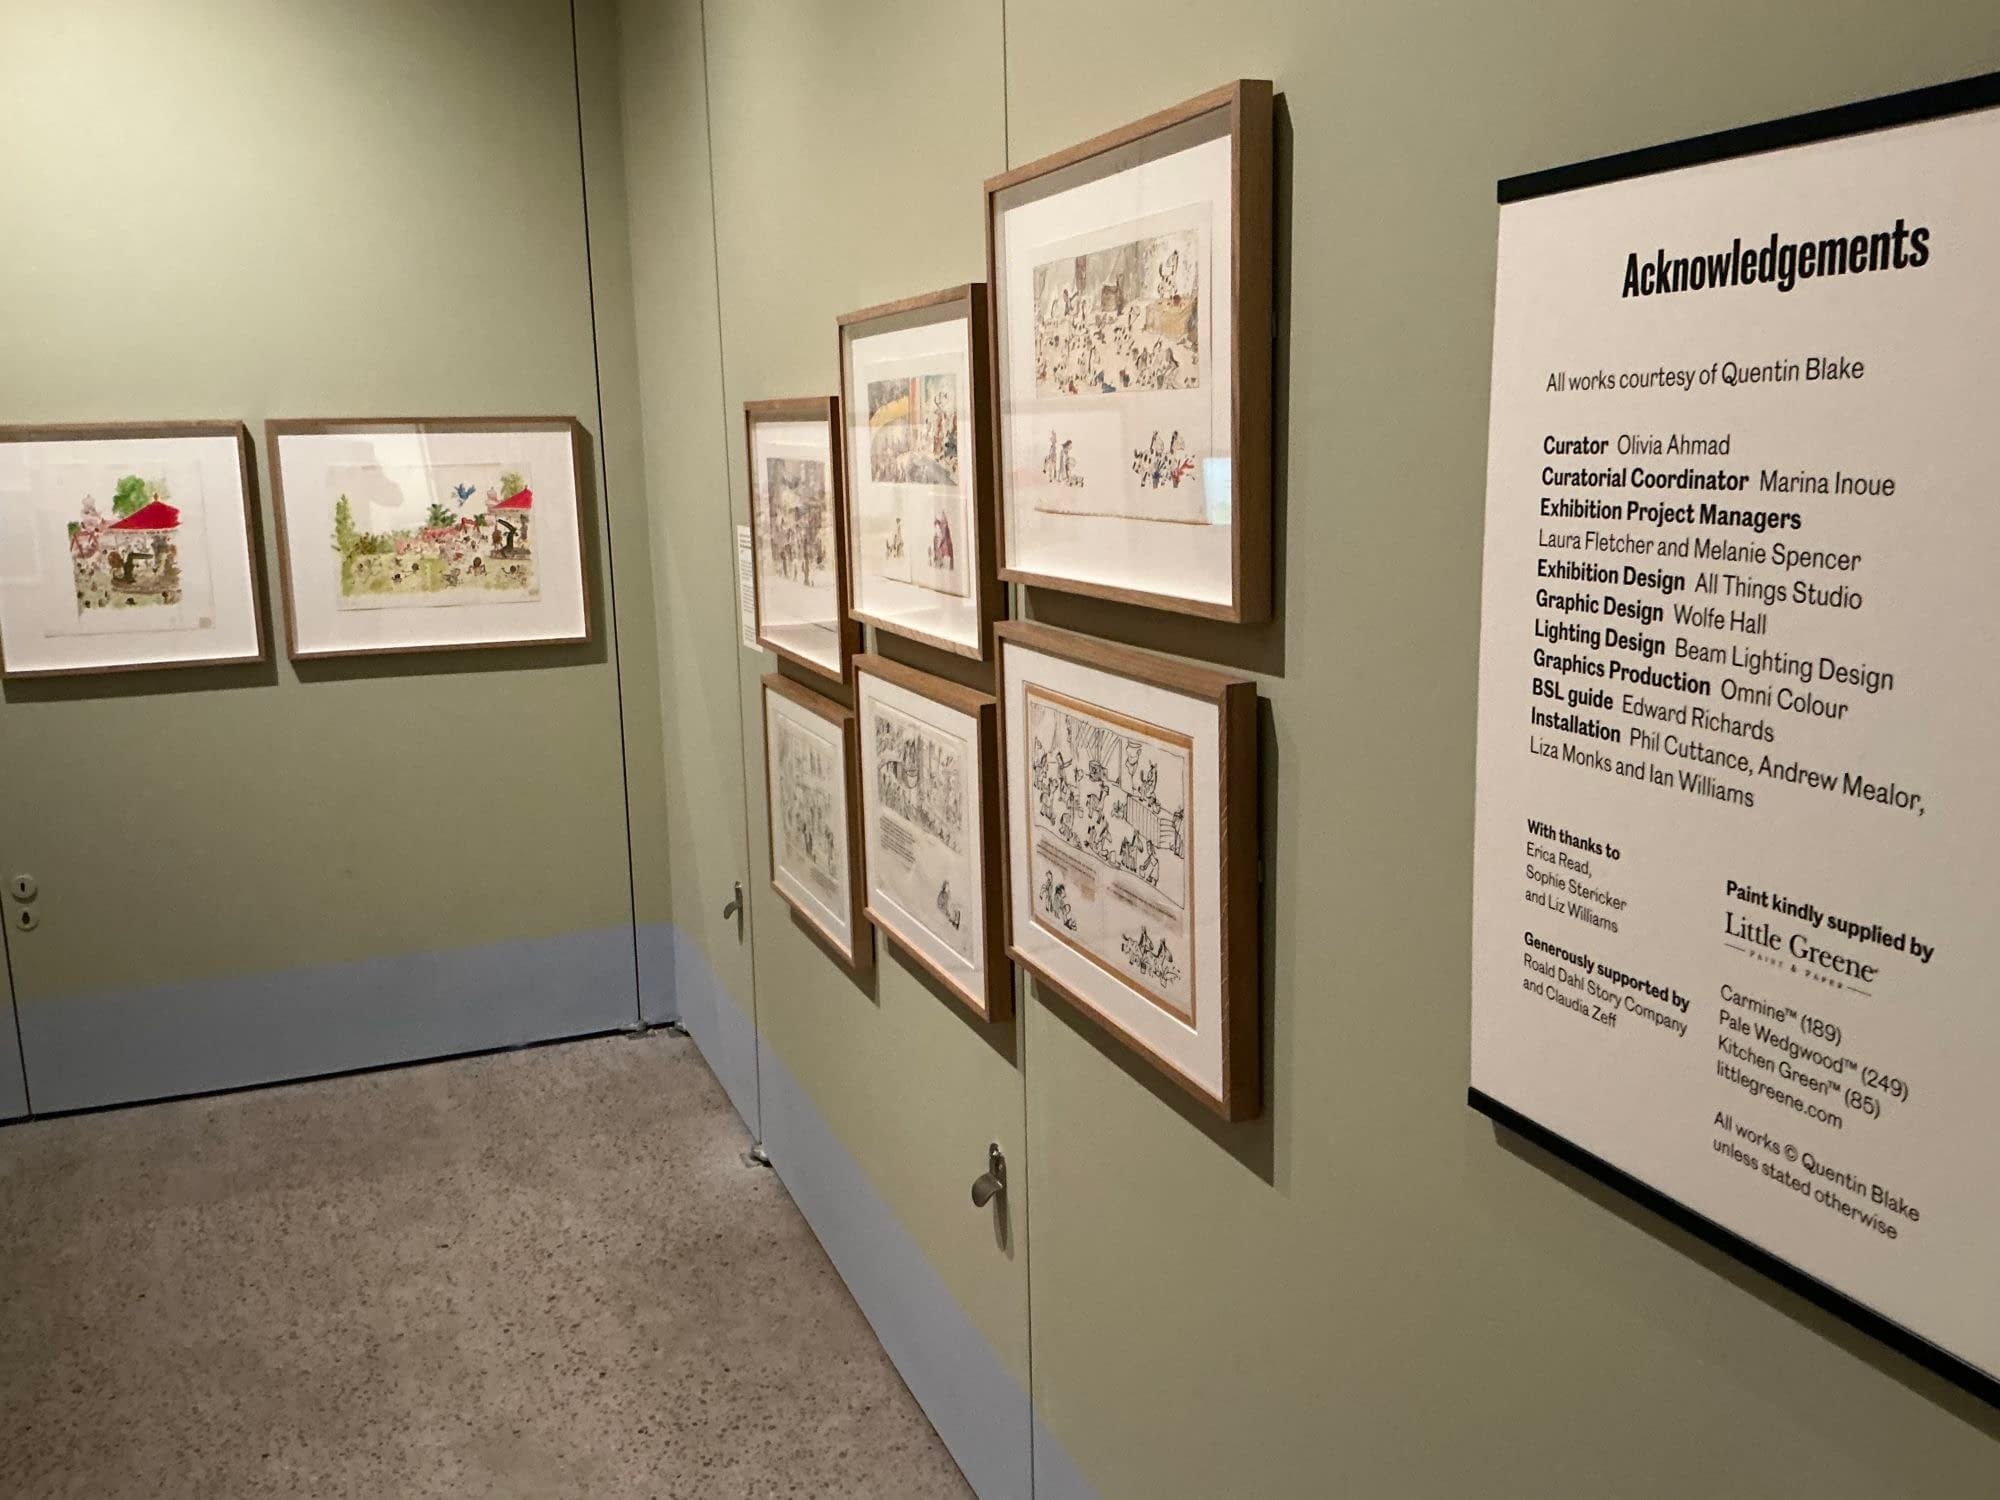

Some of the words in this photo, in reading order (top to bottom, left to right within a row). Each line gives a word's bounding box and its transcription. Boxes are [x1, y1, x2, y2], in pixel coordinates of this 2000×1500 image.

[1622, 218, 1930, 298] Acknowledgements
[1546, 372, 1565, 392] All
[1569, 370, 1615, 390] works
[1619, 367, 1696, 391] courtesy
[1699, 363, 1718, 385] of
[1722, 359, 1799, 387] Quentin
[1806, 356, 1864, 380] Blake
[1544, 435, 1609, 455] Curator
[1617, 434, 1662, 455] Olivia
[1666, 434, 1730, 455] Ahmad
[1542, 466, 1627, 487] Curatorial
[1631, 467, 1750, 491] Coordinator
[1760, 469, 1829, 494] Marina
[1835, 472, 1896, 496] Inoue
[1540, 497, 1622, 520] Exhibition
[1627, 500, 1695, 527] Project
[1699, 503, 1802, 534] Managers
[1539, 528, 1581, 550] Laura
[1585, 531, 1654, 554] Fletcher
[1657, 537, 1689, 558] and
[1694, 537, 1767, 564] Melanie
[1771, 542, 1862, 571] Spencer
[1536, 588, 1599, 615] Graphic
[1603, 595, 1664, 625] Design
[1674, 603, 1725, 630] Wolfe
[1730, 610, 1766, 635] Hall
[1538, 558, 1619, 584] Exhibition
[1623, 566, 1685, 595] Design
[1694, 572, 1718, 595] All
[1722, 574, 1787, 606] Things
[1792, 581, 1863, 610] Studio
[1533, 648, 1605, 678] Graphics
[1609, 660, 1711, 696] Production
[1721, 678, 1772, 707] Omni
[1777, 688, 1848, 719] Colour
[1535, 618, 1601, 650] Lighting
[1605, 627, 1665, 658] Design
[1675, 637, 1727, 664] Beam
[1732, 645, 1813, 683] Lighting
[1819, 658, 1893, 694] Design
[1532, 677, 1565, 701] BSL
[1568, 688, 1613, 710] guide
[1623, 694, 1687, 725] Edward
[1692, 707, 1775, 742] Richards
[1530, 736, 1559, 759] Liza
[1563, 743, 1612, 772] Monks
[1616, 761, 1645, 780] and
[1650, 763, 1674, 787] Ian
[1678, 770, 1754, 807] Williams
[1531, 706, 1621, 743] Installation
[1630, 727, 1660, 752] Phil
[1664, 735, 1753, 776] Cuttance,
[1757, 755, 1838, 791] Andrew
[1843, 773, 1925, 816] Mealor,
[1527, 819, 1556, 840] With
[1559, 829, 1603, 855] thanks
[1605, 843, 1621, 860] to
[1527, 841, 1556, 864] Erica
[1559, 852, 1592, 878] Read,
[1525, 890, 1546, 906] and
[1548, 894, 1565, 913] Liz
[1568, 901, 1618, 933] Williams
[1526, 864, 1566, 890] Sophie
[1568, 879, 1627, 910] Stericker
[1725, 911, 1781, 950] Little
[1727, 880, 1769, 908] Paint
[1772, 894, 1824, 928] kindly
[1827, 916, 1906, 952] supplied
[1910, 936, 1935, 964] by
[1524, 932, 1595, 974] Generously
[1597, 964, 1669, 1002] supported
[1672, 990, 1690, 1013] by
[1524, 953, 1555, 978] Roald
[1558, 967, 1585, 990] Dahl
[1587, 979, 1622, 1009] Story
[1624, 996, 1687, 1037] Company
[1523, 979, 1543, 996] and
[1546, 985, 1590, 1016] Claudia
[1592, 1005, 1617, 1028] Zeff
[1801, 1014, 1841, 1047] (189)
[1719, 1035, 1775, 1072] Kitchen
[1845, 1088, 1880, 1120] (85)
[1720, 1009, 1751, 1035] Pale
[1861, 1067, 1908, 1103] (249)
[1717, 1060, 1842, 1129] littlegreene.com
[1713, 1139, 1758, 1170] unless
[1762, 1163, 1811, 1196] stated
[1814, 1190, 1897, 1239] otherwise
[1714, 1111, 1732, 1131] All
[1736, 1124, 1780, 1155] works
[1802, 1153, 1866, 1197] Quentin
[1871, 1184, 1919, 1221] Blake
